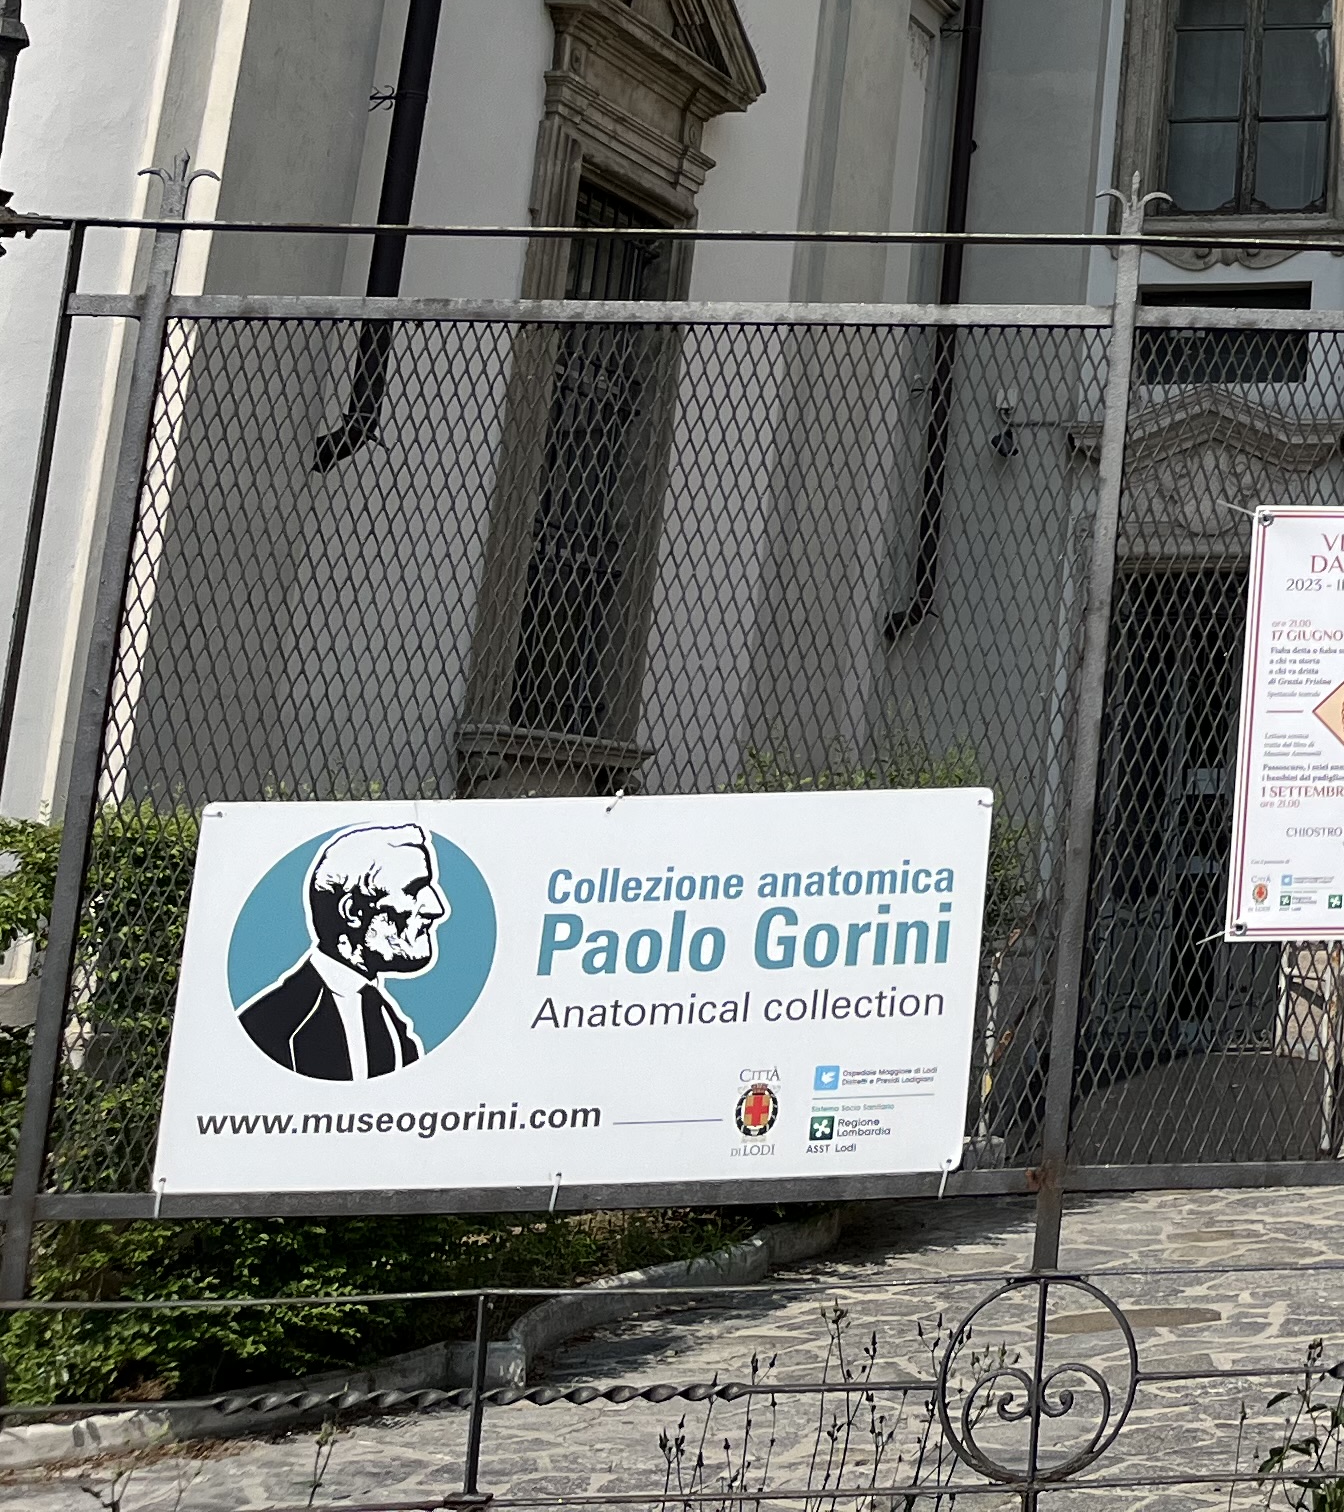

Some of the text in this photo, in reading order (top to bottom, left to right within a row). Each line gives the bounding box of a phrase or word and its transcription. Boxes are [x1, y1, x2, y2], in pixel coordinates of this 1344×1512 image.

[1286, 578, 1322, 591] 2023
[1271, 629, 1344, 642] 17 GIUGNO
[1286, 826, 1342, 837] CHIOSTRO
[546, 859, 955, 904] Collezione anatomica
[536, 901, 953, 977] Paolo Gorini
[530, 986, 945, 1030] Anatomical collection
[196, 1101, 602, 1140] www.museogorini.com
[838, 1118, 880, 1129] Regione
[836, 1127, 891, 1137] Lombardia
[730, 1143, 776, 1157] DI LODI
[806, 1143, 857, 1154] ASST Lodi
